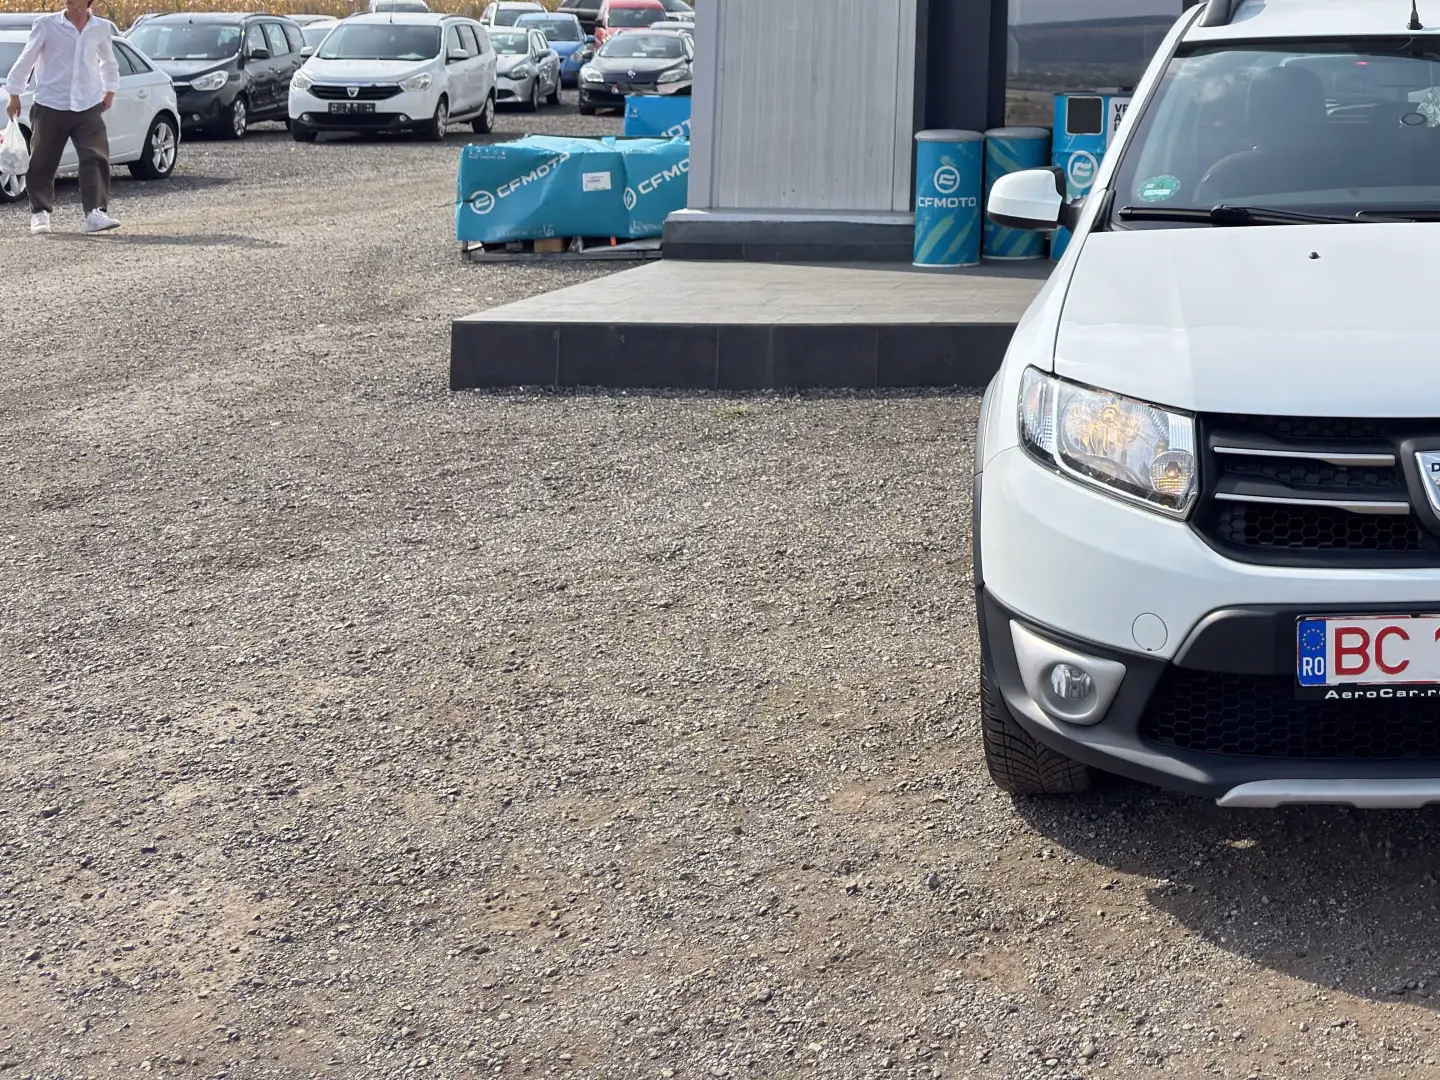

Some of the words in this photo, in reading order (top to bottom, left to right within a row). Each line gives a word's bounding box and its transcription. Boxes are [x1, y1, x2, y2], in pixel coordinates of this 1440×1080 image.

[496, 151, 571, 198] CFMOTO
[637, 158, 690, 194] CFMO
[918, 196, 977, 208] CFMOTO
[1302, 656, 1325, 676] RO
[1334, 625, 1411, 676] BC
